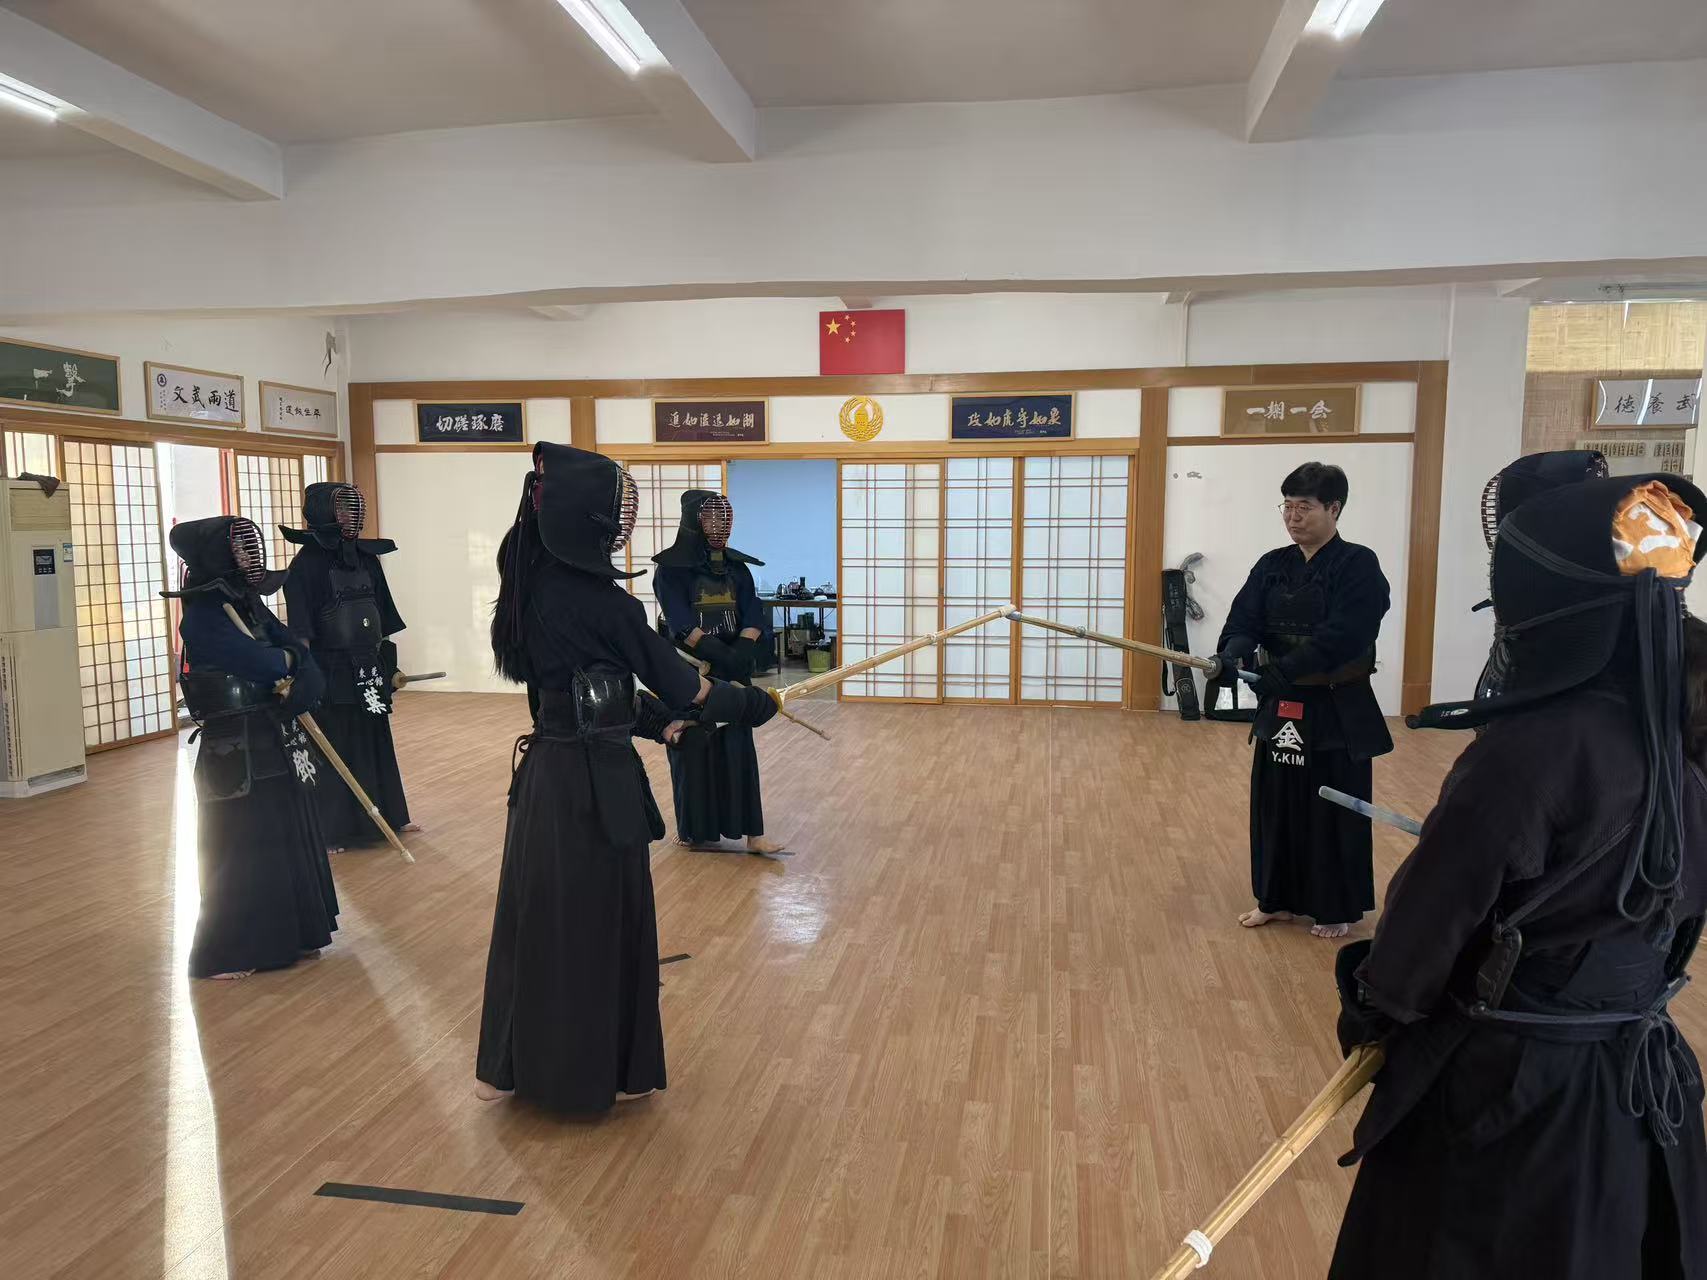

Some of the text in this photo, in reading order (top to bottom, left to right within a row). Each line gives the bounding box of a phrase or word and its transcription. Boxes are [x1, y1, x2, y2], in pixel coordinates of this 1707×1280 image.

[436, 413, 504, 432] 切磋琢磨
[1271, 751, 1305, 766] Y.KIM
